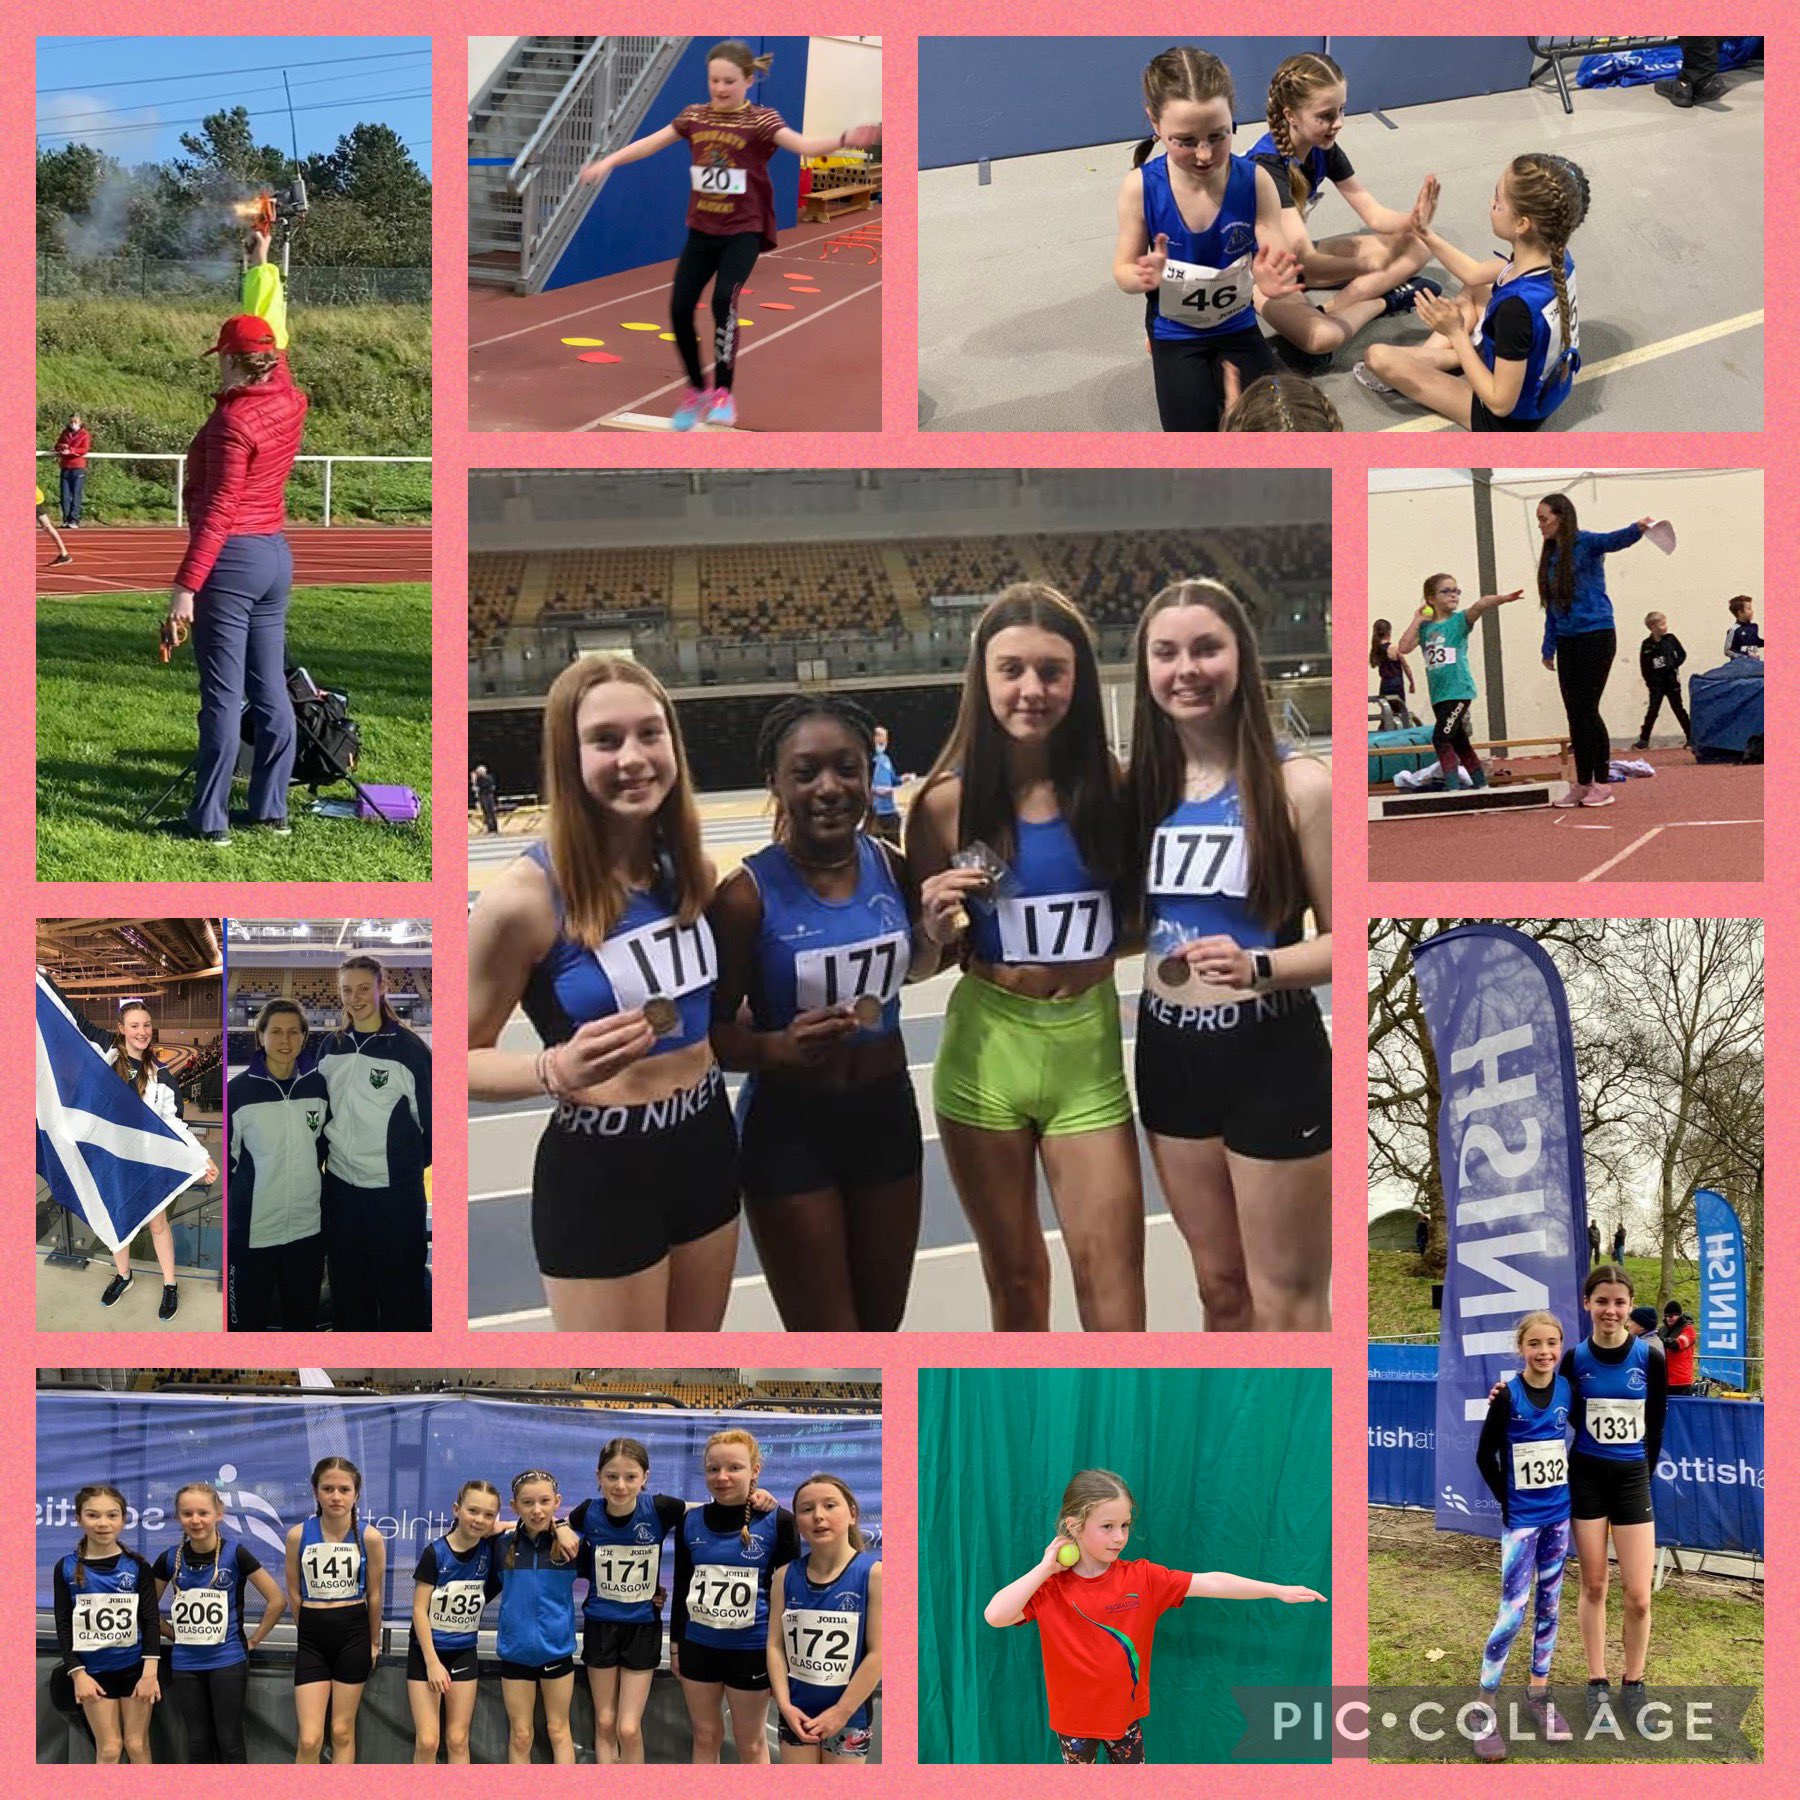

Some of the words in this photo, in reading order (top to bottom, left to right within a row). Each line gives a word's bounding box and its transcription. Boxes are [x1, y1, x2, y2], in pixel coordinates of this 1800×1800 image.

[702, 166, 731, 191] 20
[1181, 285, 1238, 312] 46
[1428, 648, 1447, 665] 23
[1443, 702, 1465, 735] adidas
[1154, 834, 1234, 888] 177
[1024, 898, 1100, 956] 177
[628, 923, 708, 994] 177
[824, 941, 897, 1007] 177
[1178, 1002, 1240, 1031] PRO
[1592, 1416, 1638, 1440] 1331
[1520, 1458, 1565, 1485] 1332
[307, 1556, 353, 1579] 141
[601, 1559, 649, 1583] 171
[310, 1579, 355, 1589] GLASGOW
[600, 1582, 650, 1593] GLASGOW
[695, 1581, 751, 1608] 170
[175, 1602, 223, 1625] 206
[437, 1594, 481, 1616] 135
[692, 1605, 749, 1618] GLASGOW
[79, 1607, 132, 1631] 163
[433, 1612, 478, 1624] GLASGOW
[816, 1615, 848, 1624] Joma
[78, 1631, 132, 1641] GLASGOW
[177, 1626, 222, 1635] GLASGOW
[788, 1627, 850, 1660] 172
[790, 1656, 847, 1672] GLASGOW
